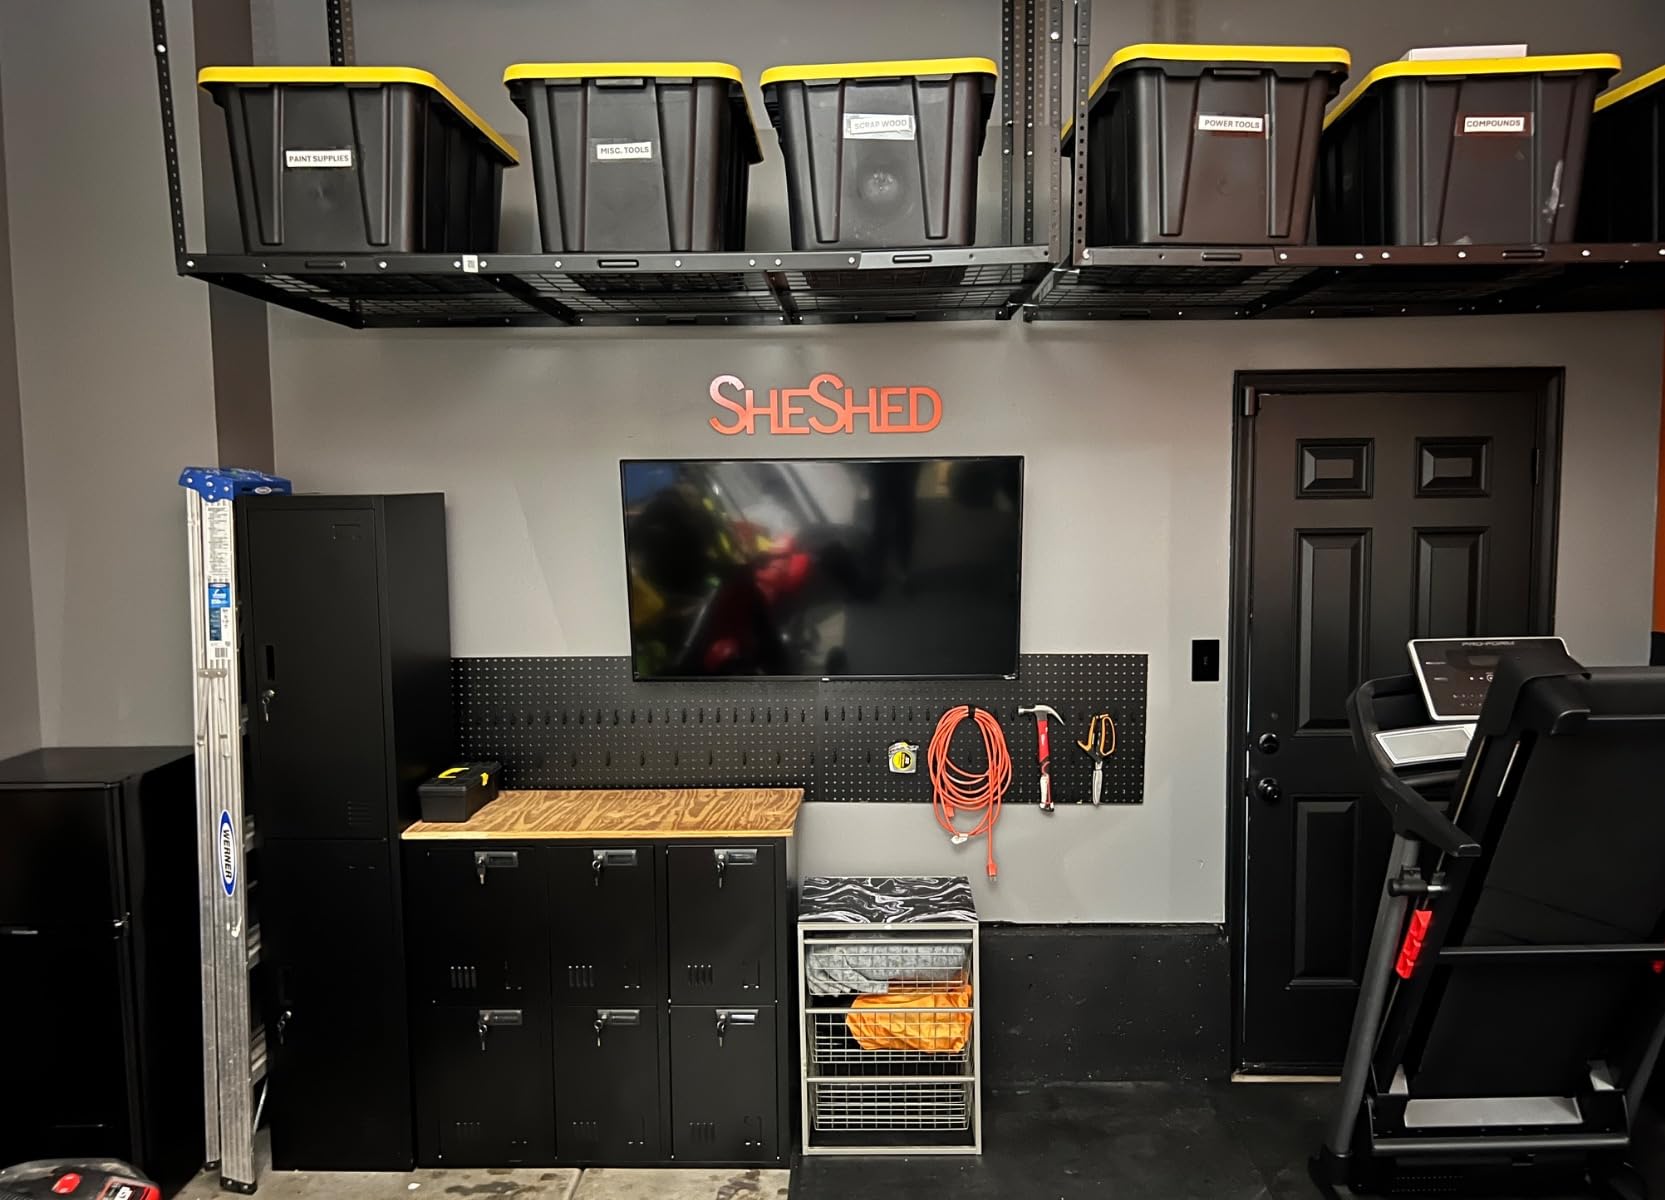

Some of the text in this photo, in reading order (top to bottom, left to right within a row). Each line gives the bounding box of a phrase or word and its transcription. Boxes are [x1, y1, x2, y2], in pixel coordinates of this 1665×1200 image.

[854, 119, 907, 130] SCRAP WOOD
[1204, 119, 1260, 129] POWER TOOLS
[1466, 119, 1521, 128] COMPOUNDS
[223, 829, 233, 879] WERNER
